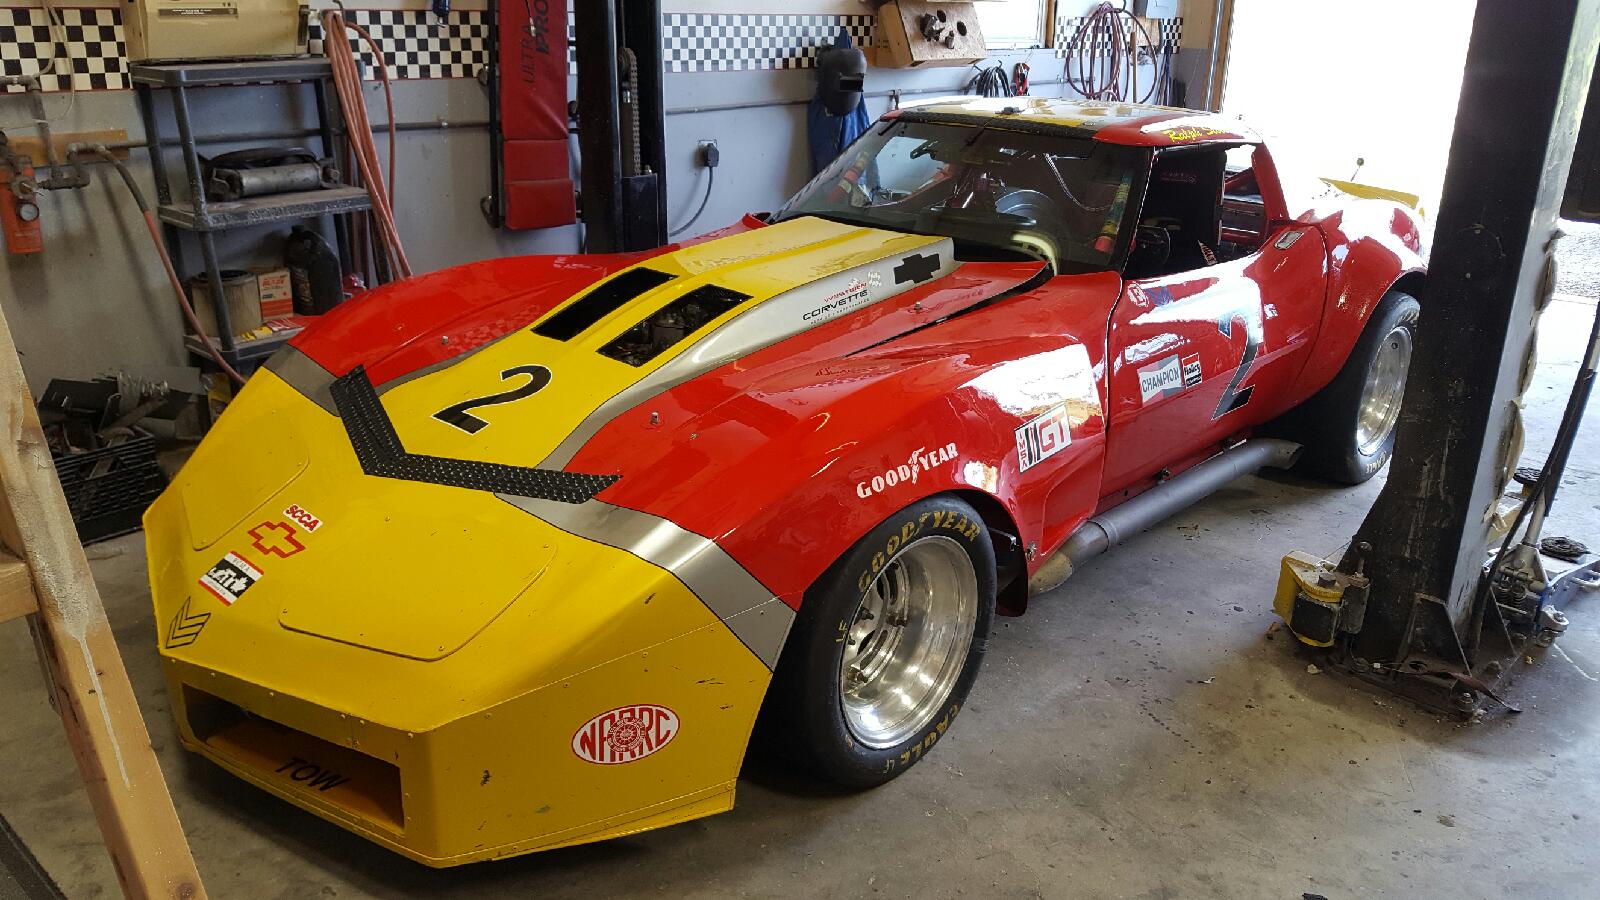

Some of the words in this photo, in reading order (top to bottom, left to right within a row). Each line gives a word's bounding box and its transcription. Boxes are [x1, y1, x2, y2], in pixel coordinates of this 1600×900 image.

[802, 289, 868, 321] CORVETTE
[1210, 302, 1262, 421] 2
[1141, 366, 1180, 393] CHAMPION
[430, 363, 552, 435] 2
[1038, 410, 1067, 453] GT
[285, 504, 320, 532] SCCA
[275, 757, 353, 791] TOW
